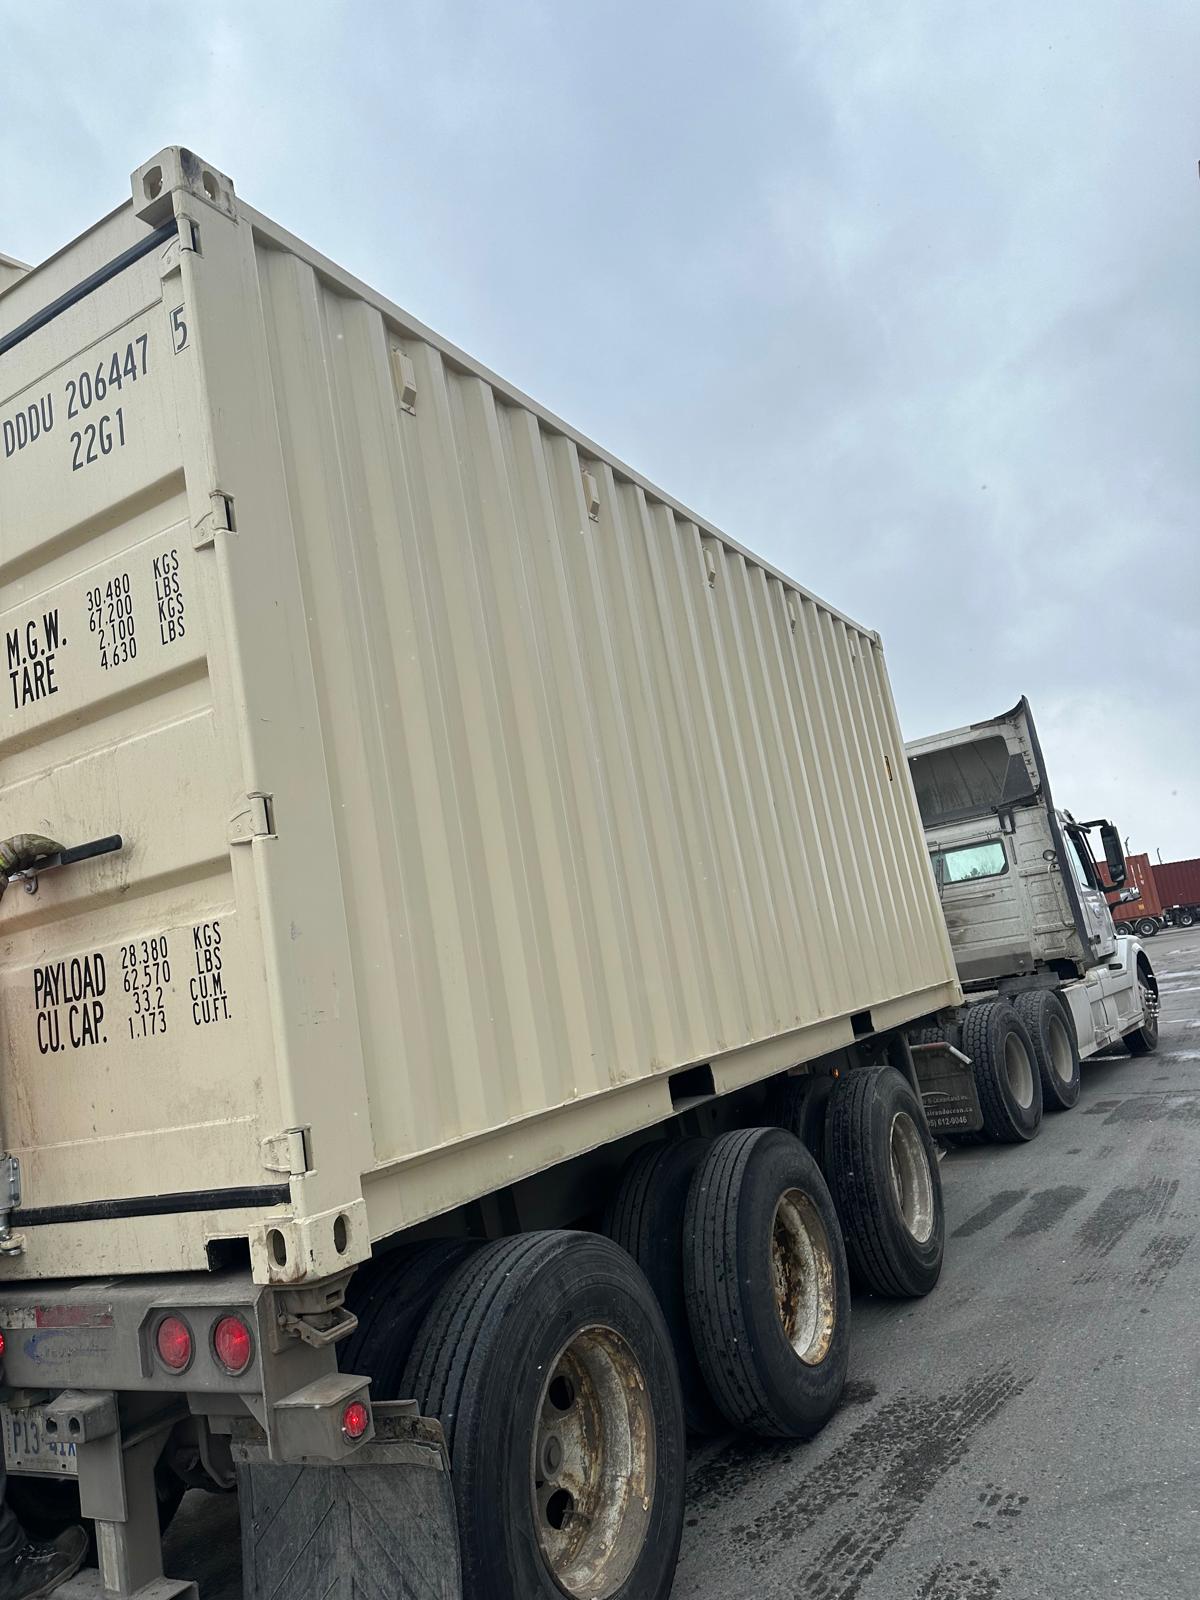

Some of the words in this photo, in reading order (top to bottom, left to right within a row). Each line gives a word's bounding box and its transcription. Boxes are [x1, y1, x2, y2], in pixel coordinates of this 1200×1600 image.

[3, 392, 54, 458] DDDU
[65, 333, 148, 420] 206447
[173, 306, 187, 350] 5
[70, 407, 125, 472] 22G1
[6, 609, 67, 670] M.G.W.
[87, 573, 130, 611] 30.480
[153, 549, 179, 579] KGS
[89, 595, 132, 632] 67.200
[155, 572, 180, 601] LBS
[9, 654, 59, 709] TARE
[98, 616, 135, 650] 2.100
[158, 593, 185, 622] KGS
[101, 637, 137, 671] 4.630
[160, 615, 186, 645] LBS
[33, 953, 106, 1009] PAYLOAD
[121, 936, 168, 969] 28.380
[193, 921, 221, 950] KGS
[124, 960, 170, 992] 62.570
[196, 947, 222, 975] LBS
[132, 987, 164, 1014] 33.2
[190, 972, 226, 1001] CU.M.
[128, 1011, 167, 1040] 1.173
[192, 996, 232, 1025] CU.FT.
